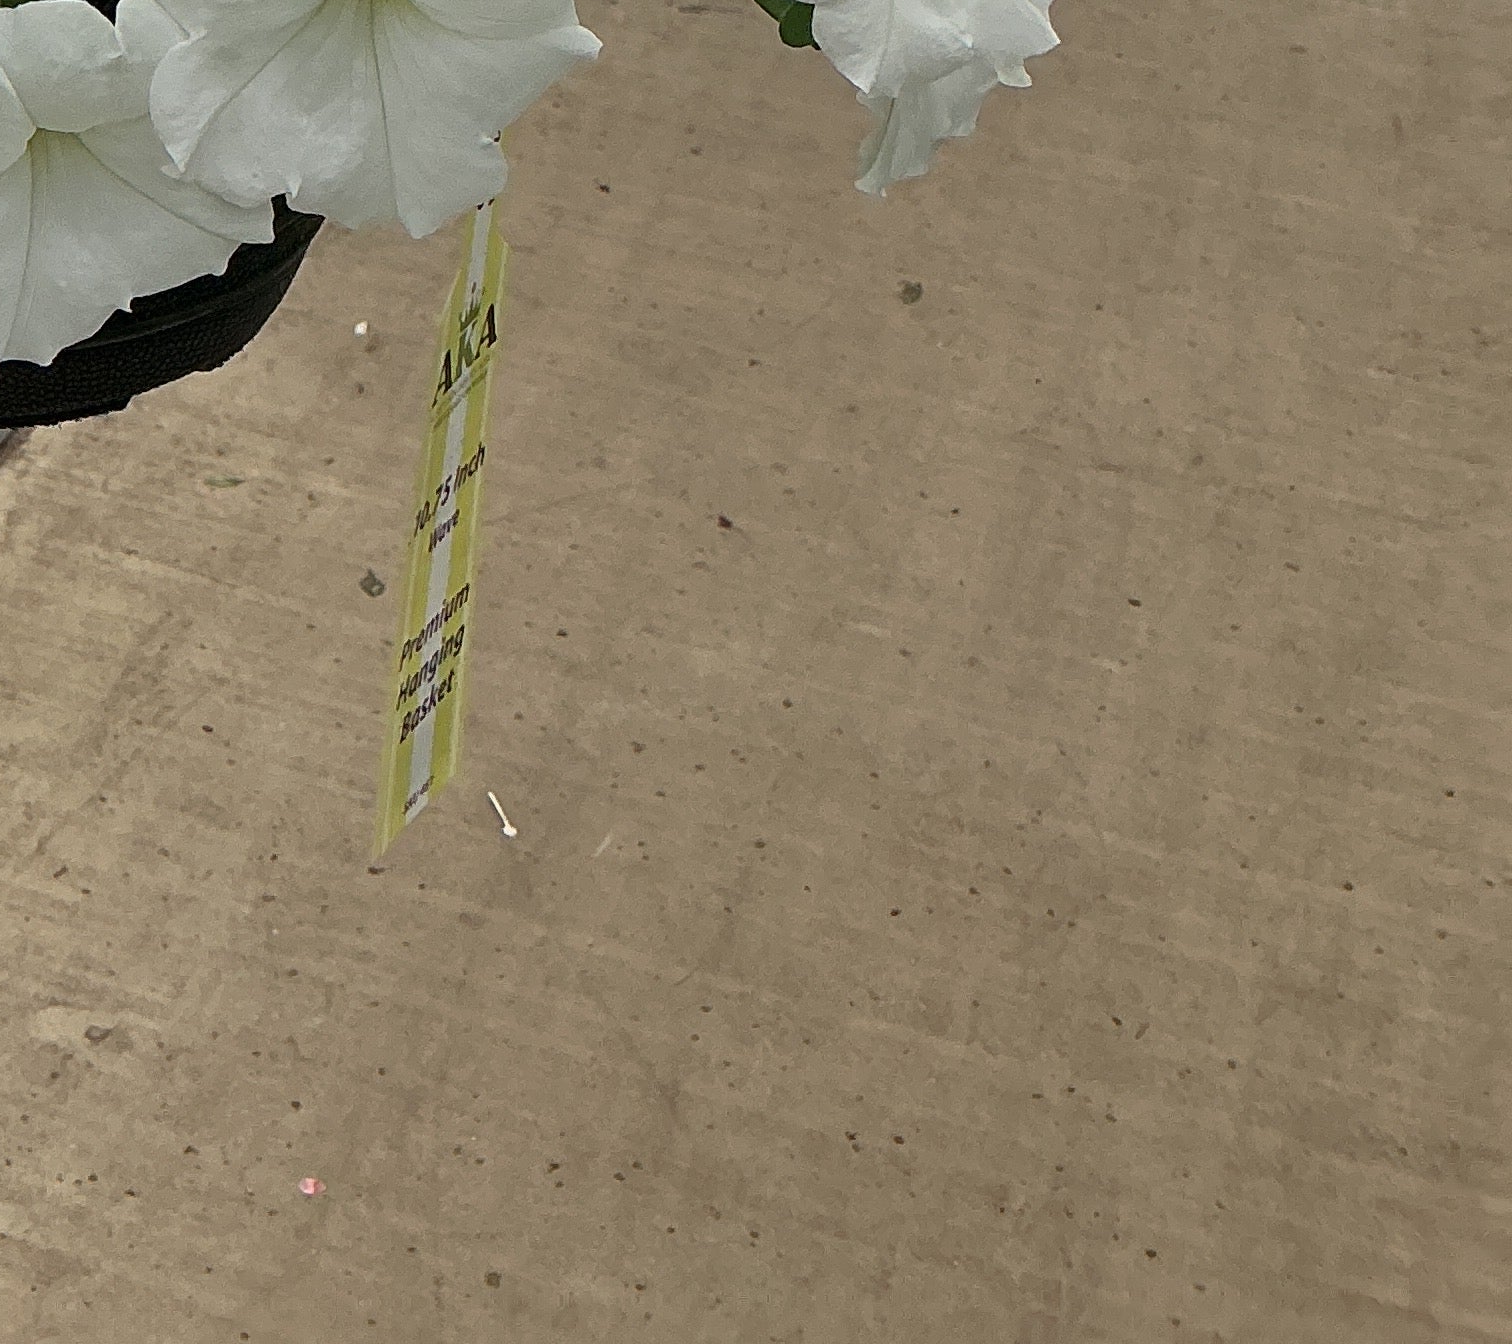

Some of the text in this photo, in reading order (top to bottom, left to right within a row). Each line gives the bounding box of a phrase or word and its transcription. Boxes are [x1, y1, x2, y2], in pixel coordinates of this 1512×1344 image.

[432, 303, 497, 409] AKA
[453, 441, 486, 494] Inch
[396, 624, 465, 711] Hanging
[399, 582, 470, 672] Premium
[399, 668, 456, 744] Basket
